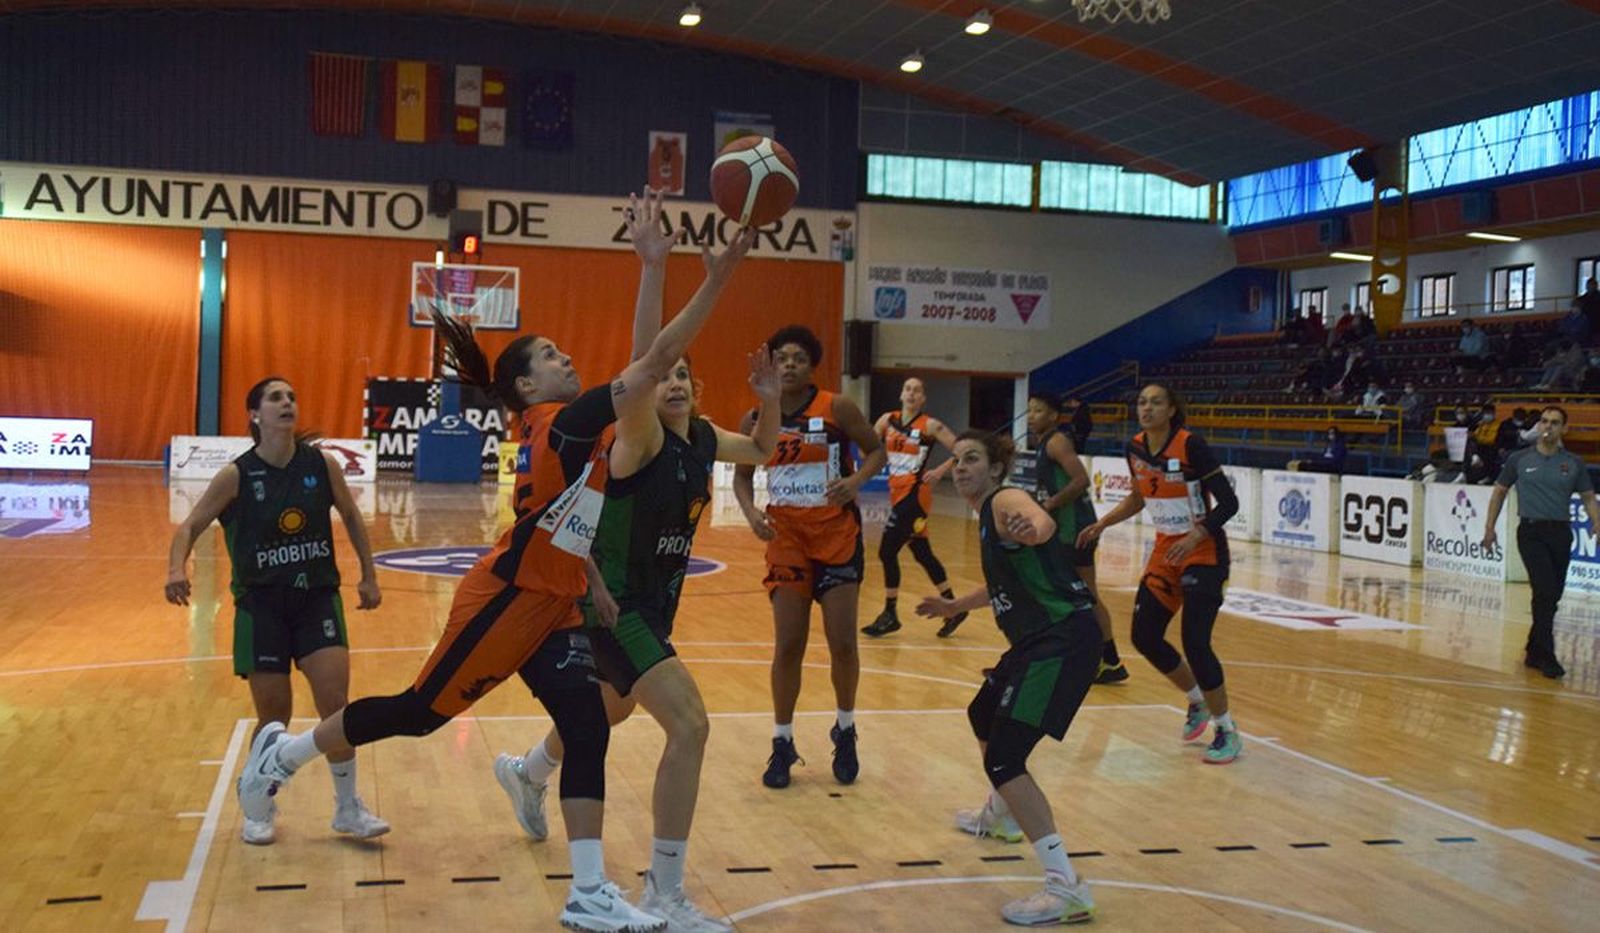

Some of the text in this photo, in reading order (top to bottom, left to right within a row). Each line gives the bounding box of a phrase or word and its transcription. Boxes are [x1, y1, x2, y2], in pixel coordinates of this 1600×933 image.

[24, 172, 424, 230] AYUNTAMIENTO
[487, 200, 549, 238] DE
[933, 290, 986, 302] TEMPORADA
[921, 303, 997, 323] 2007-2008
[373, 406, 503, 431] ZAMRA
[1344, 492, 1408, 544] G3C
[256, 540, 331, 569] PROBITAS
[1426, 530, 1504, 563] Recoletas
